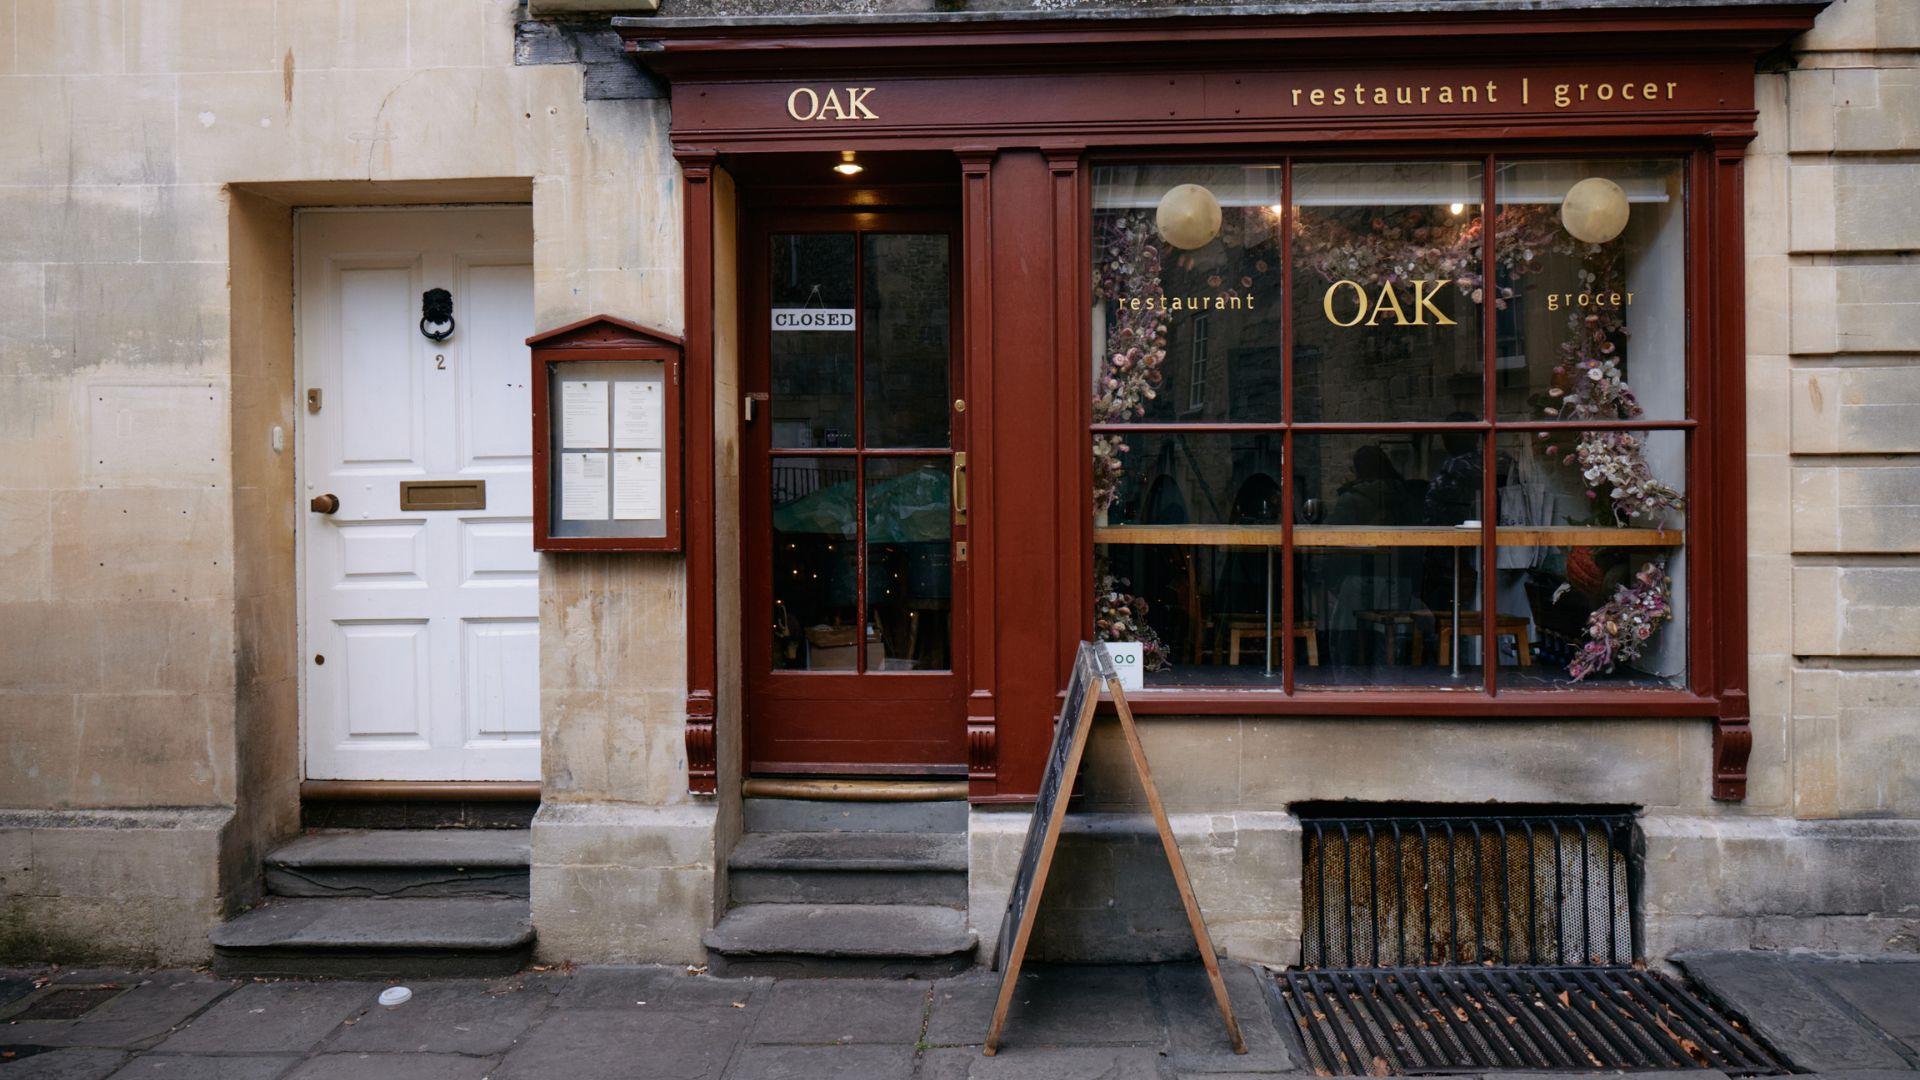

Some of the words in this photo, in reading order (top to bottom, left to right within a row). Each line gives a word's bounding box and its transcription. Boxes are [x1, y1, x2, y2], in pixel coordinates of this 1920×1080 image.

[787, 87, 879, 120] OAK
[1291, 80, 1497, 106] restaurant
[1554, 82, 1677, 108] grocer
[1118, 292, 1255, 311] restaurant
[1323, 279, 1458, 327] OAK
[1547, 292, 1634, 311] grocer
[775, 313, 854, 326] CLOSED
[435, 354, 446, 370] 2
